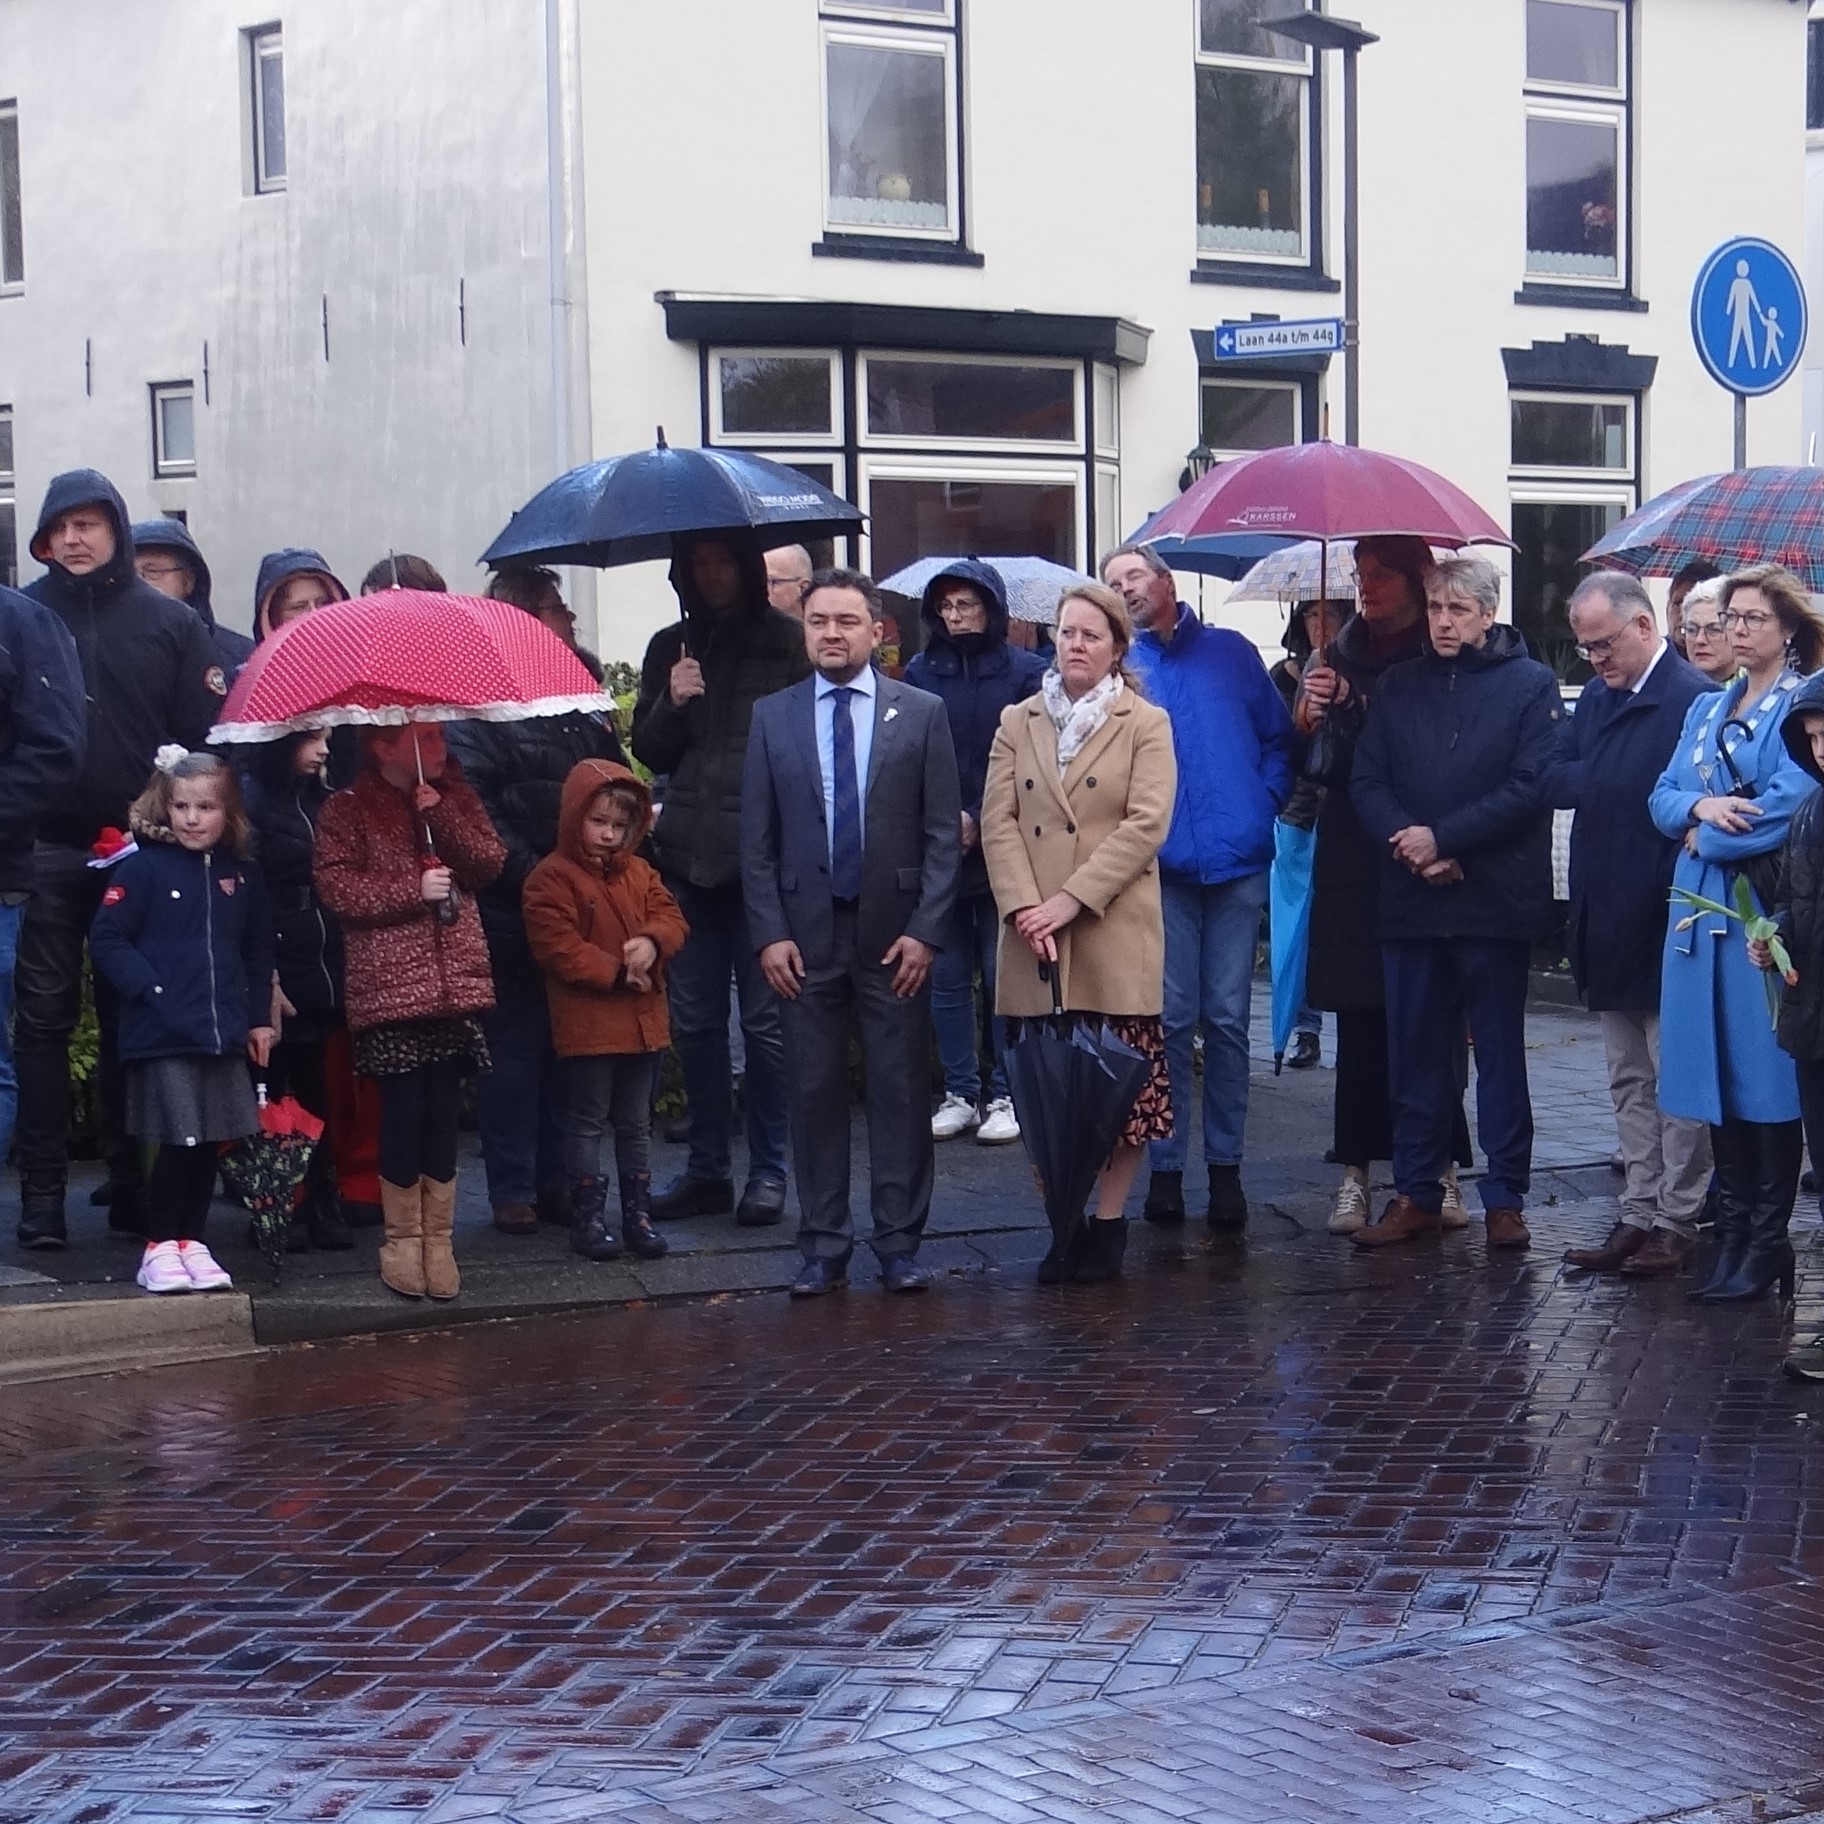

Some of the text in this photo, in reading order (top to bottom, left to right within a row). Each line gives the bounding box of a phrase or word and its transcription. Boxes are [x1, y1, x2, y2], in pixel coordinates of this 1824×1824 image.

[1239, 329, 1334, 347] Laan 44a t/m 44g
[1249, 511, 1297, 522] KARSSEN
